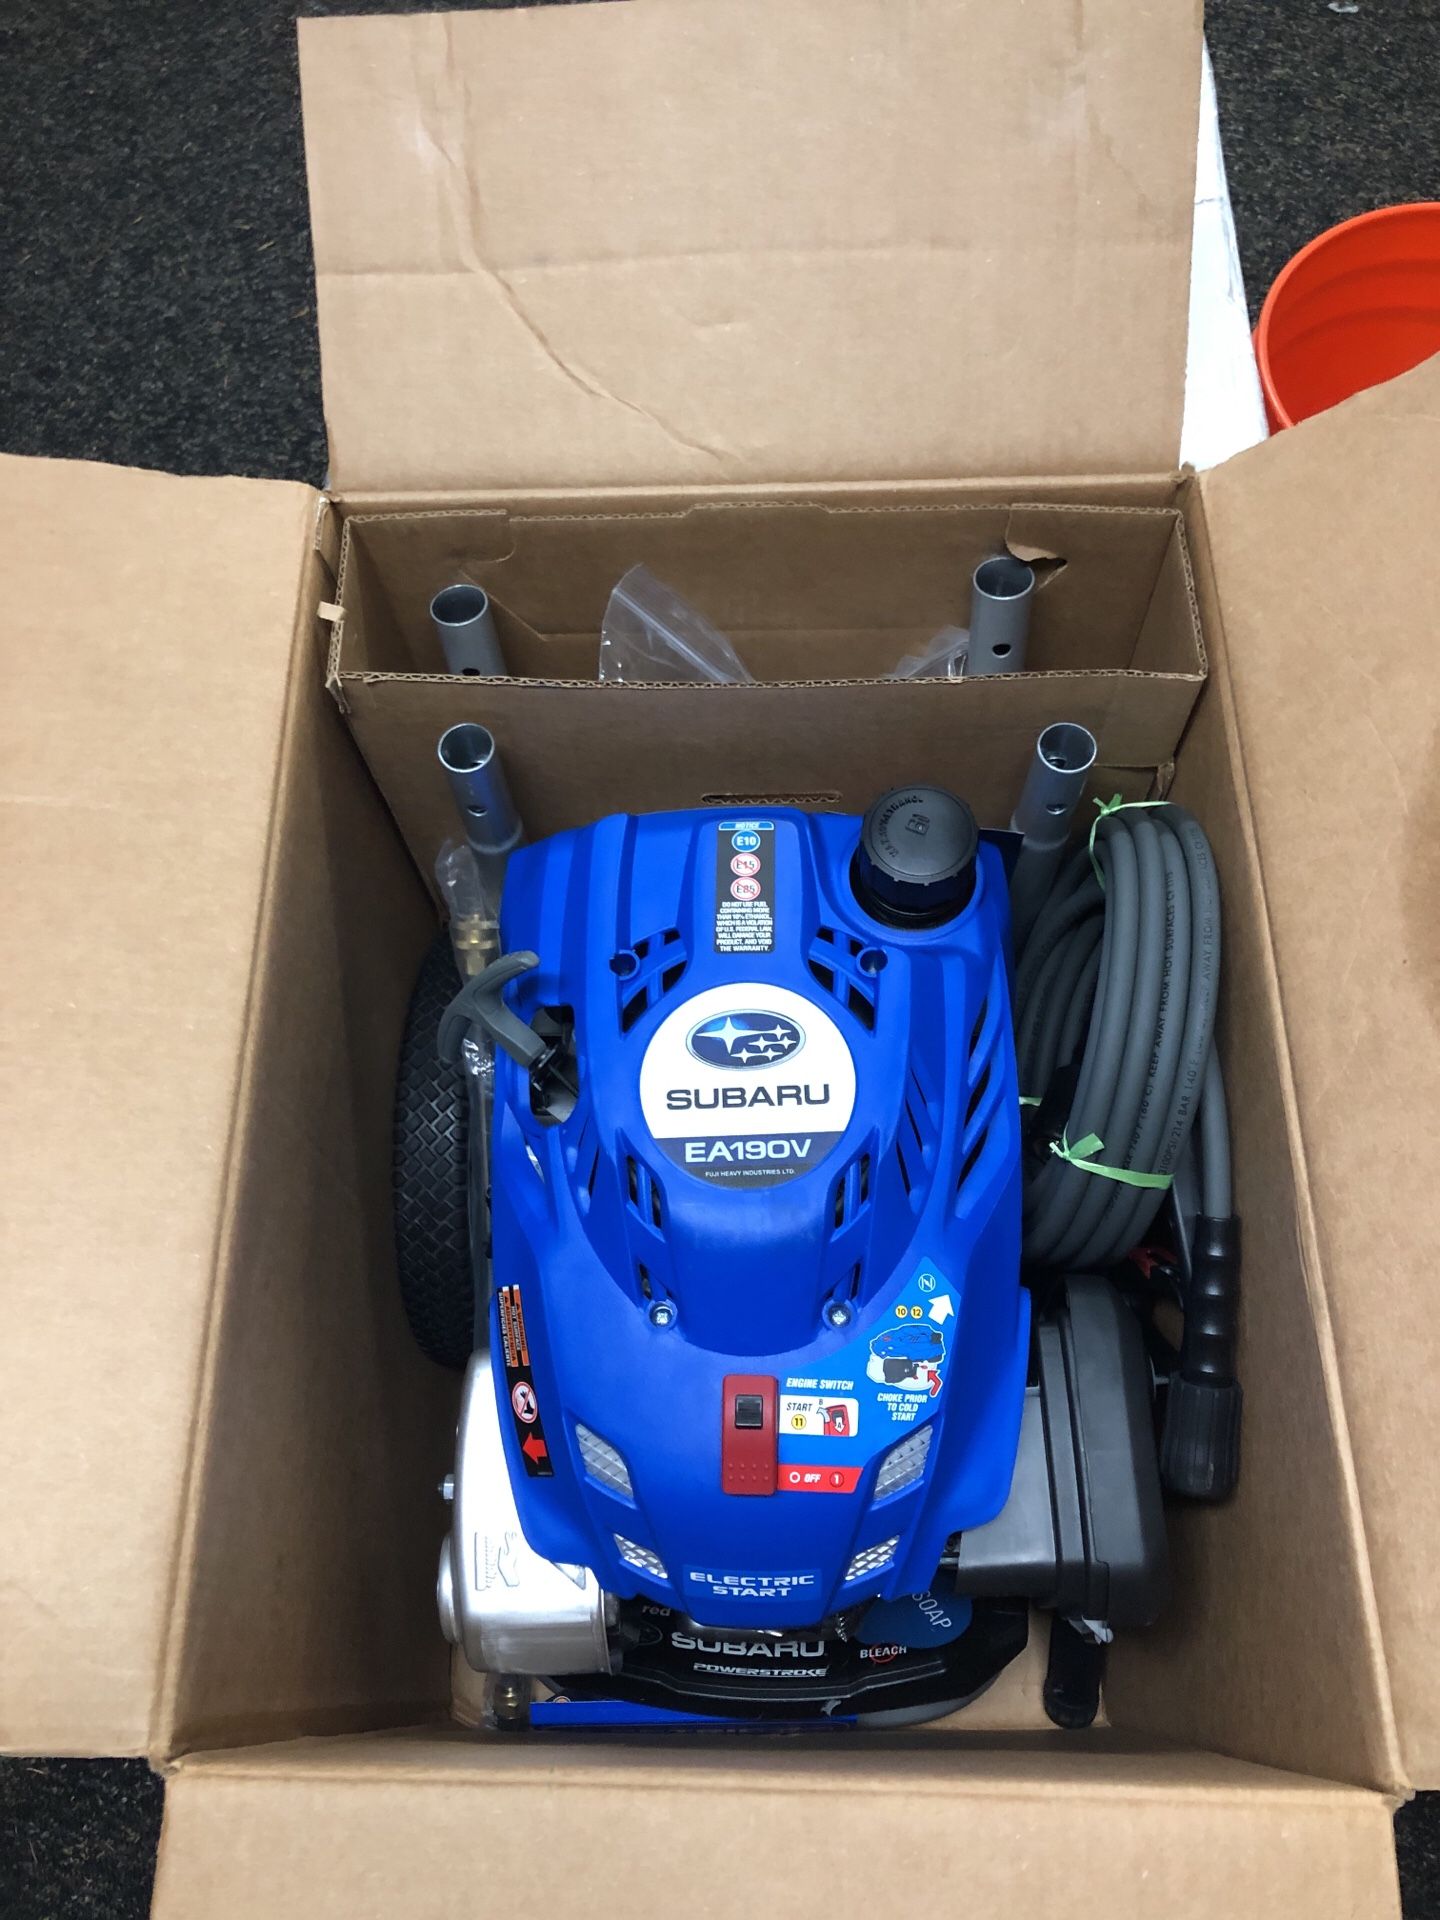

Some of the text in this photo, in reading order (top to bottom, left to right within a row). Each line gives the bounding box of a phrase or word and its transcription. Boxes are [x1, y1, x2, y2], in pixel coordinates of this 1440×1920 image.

[736, 835, 757, 846] E10
[736, 859, 755, 870] E15
[736, 883, 756, 894] E85
[1165, 905, 1176, 951] SURFACES
[1203, 917, 1213, 946] FROM
[1163, 954, 1173, 977] HOT
[1203, 950, 1213, 981] AWAY
[1159, 981, 1170, 1012] FROM
[1155, 1016, 1166, 1048] AWAY
[1149, 1052, 1159, 1078] KEEP
[666, 1083, 830, 1110] SUBARU
[1178, 1095, 1191, 1116] BAR
[684, 1138, 812, 1163] EA190V
[742, 1168, 781, 1176] INDUSTRIES
[897, 1306, 921, 1317] 10 12
[786, 1377, 854, 1390] ENGINE SWITCH
[877, 1392, 928, 1403] CHOKE PRIOR
[786, 1402, 813, 1412] START
[887, 1402, 918, 1412] TO COLD
[794, 1417, 803, 1427] 11
[892, 1412, 916, 1421] START
[804, 1473, 821, 1483] OFF
[690, 1571, 814, 1586] ELECTRIC
[713, 1586, 792, 1597] START
[912, 1590, 952, 1628] SOAP
[671, 1631, 825, 1658] SUBARU
[860, 1645, 907, 1659] BLEACH
[693, 1662, 830, 1677] POWERSTROKE
